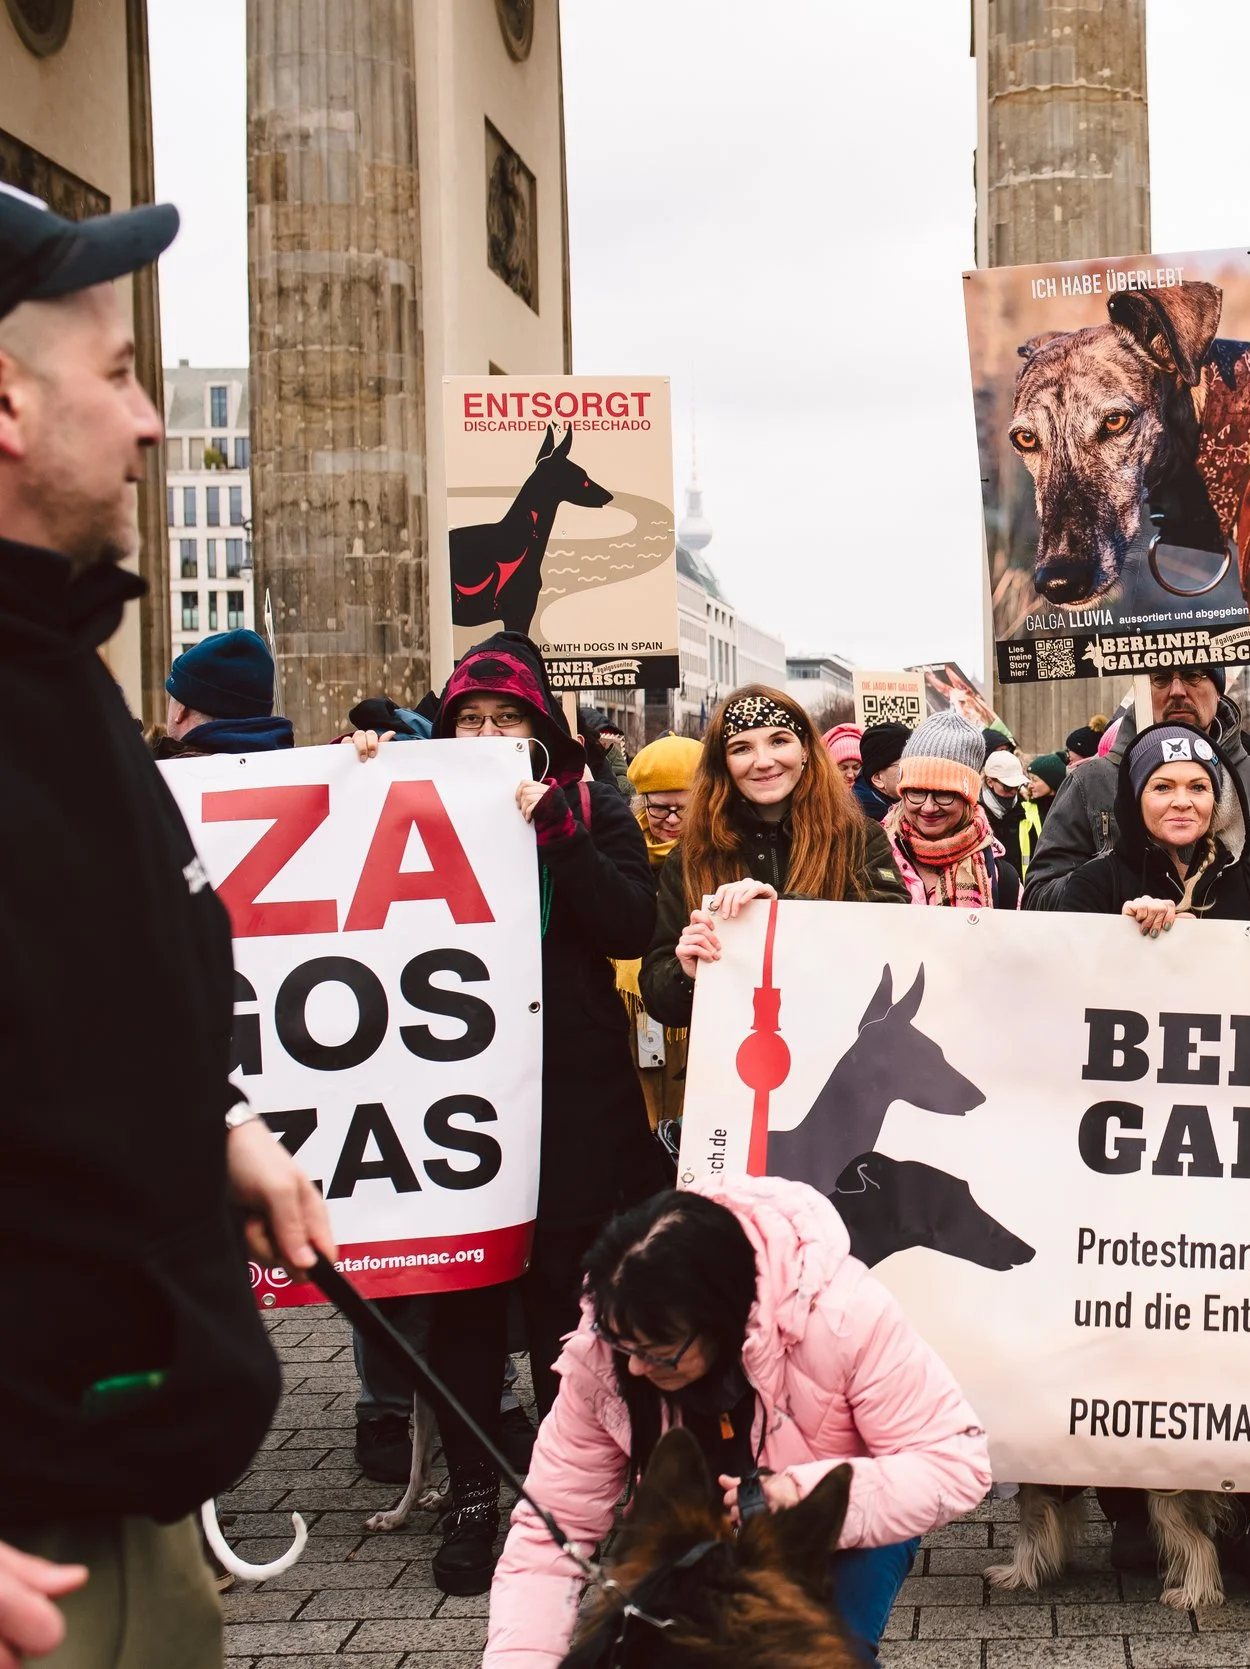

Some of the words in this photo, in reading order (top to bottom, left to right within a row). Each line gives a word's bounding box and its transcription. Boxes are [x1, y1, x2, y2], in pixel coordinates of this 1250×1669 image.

[1031, 277, 1057, 299] ICH
[1061, 274, 1102, 297] HABE
[1106, 267, 1185, 293] ÜBERLEBT
[463, 391, 651, 418] ENTSORGT
[464, 420, 546, 432] DISCARDED
[563, 419, 651, 431] DESECHADO
[1026, 613, 1066, 632] GALGA
[1068, 609, 1114, 628] LLUVIA
[1119, 612, 1172, 624] aussortiert
[1174, 610, 1193, 620] und
[1195, 606, 1250, 620] abgegeben
[553, 643, 581, 653] WITH
[583, 642, 615, 652] DOGS
[618, 642, 629, 651] IN
[631, 641, 663, 651] SPAIN
[1101, 630, 1212, 654] BERLINER
[1009, 653, 1032, 661] meine
[1009, 661, 1030, 670] Story
[548, 673, 636, 687] OMARSCH
[1074, 1291, 1132, 1328] und
[1144, 1292, 1191, 1331] die
